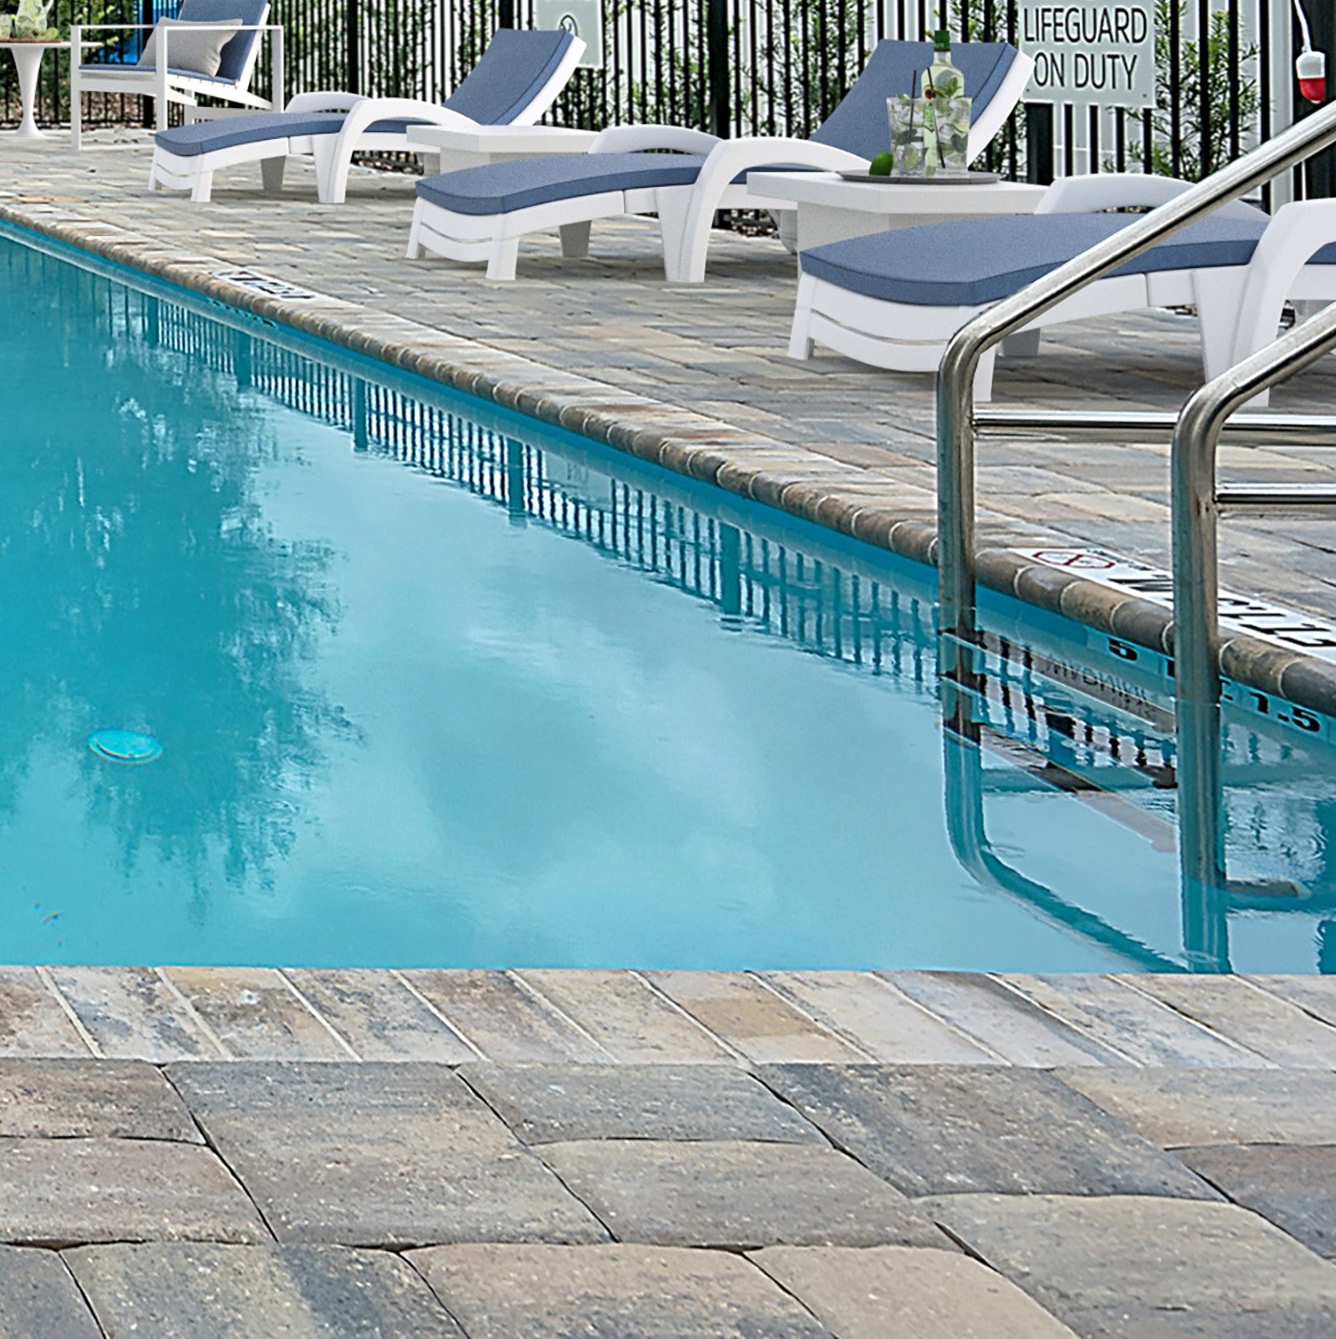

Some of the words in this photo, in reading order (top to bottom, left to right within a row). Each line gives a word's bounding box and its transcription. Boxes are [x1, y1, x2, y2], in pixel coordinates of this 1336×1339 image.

[1023, 7, 1147, 44] LIFEGUARD
[1034, 52, 1065, 88] ON
[1074, 53, 1138, 90] DUTY
[1107, 637, 1138, 661] 5
[1249, 691, 1321, 732] 1.5
